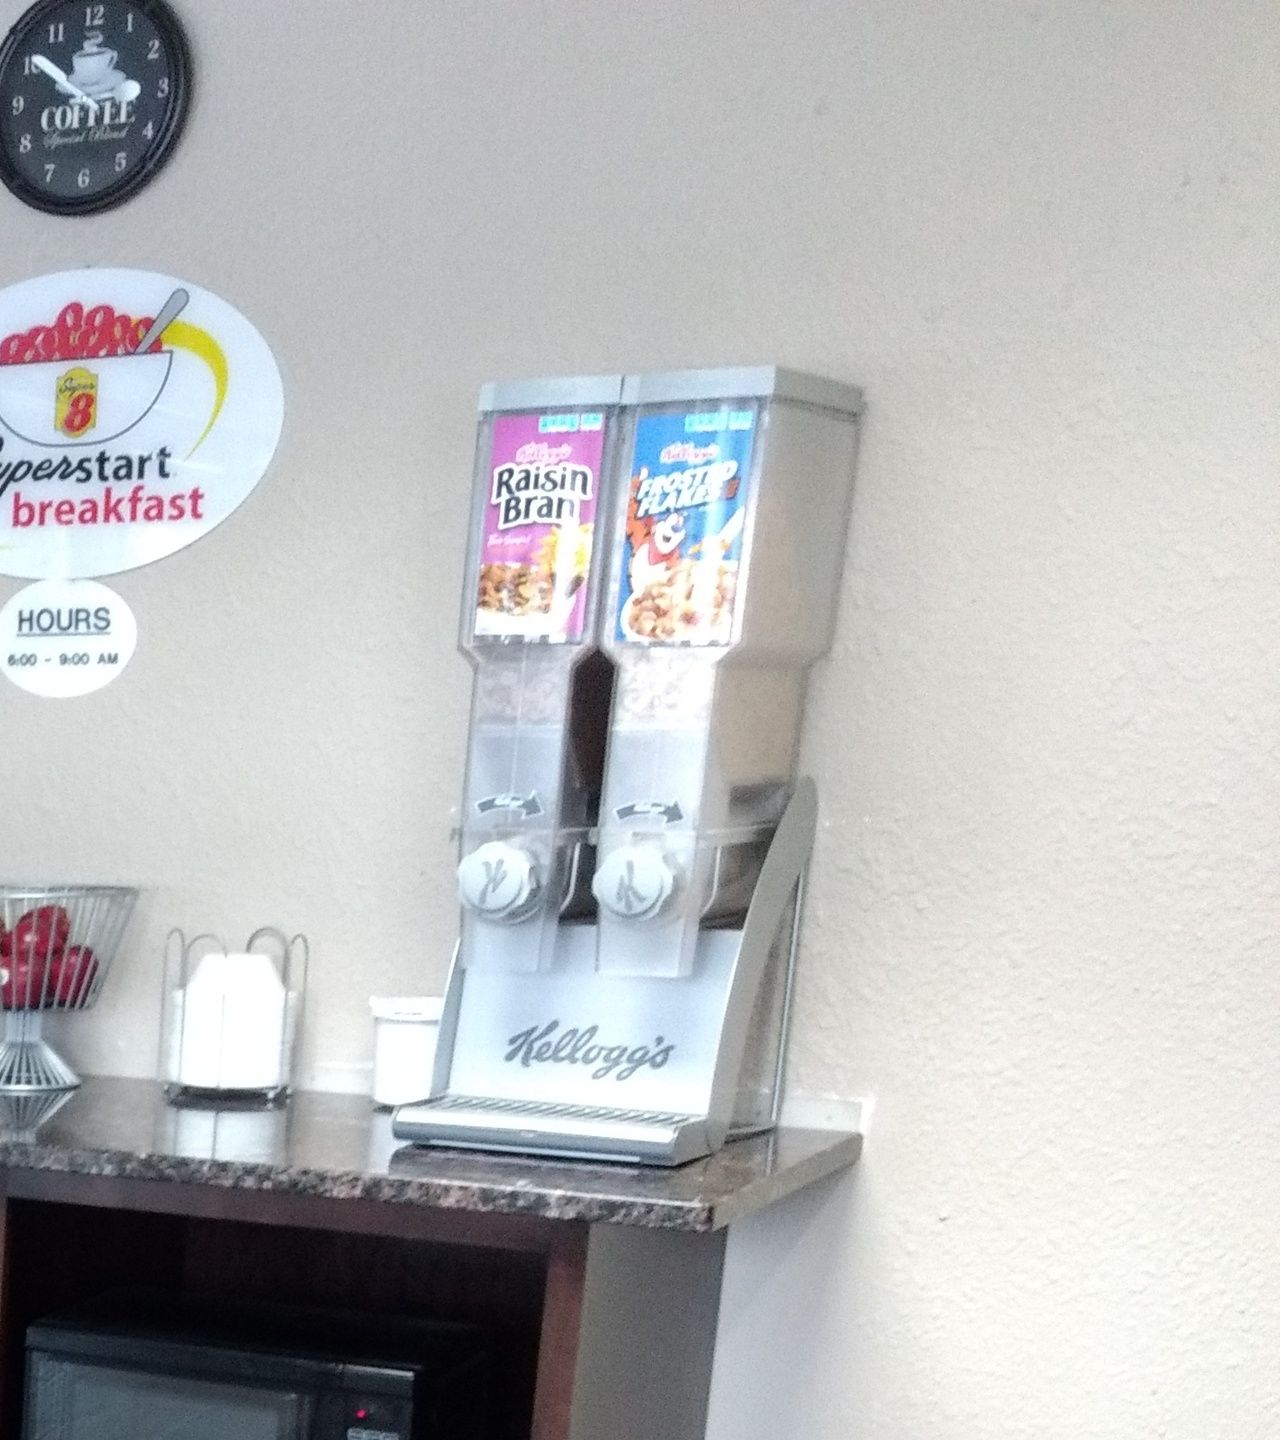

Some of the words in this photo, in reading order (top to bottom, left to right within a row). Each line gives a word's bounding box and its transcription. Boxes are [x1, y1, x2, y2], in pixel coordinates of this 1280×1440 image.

[85, 5, 104, 26] 12
[125, 13, 134, 33] 1
[48, 23, 65, 43] 11
[147, 39, 160, 60] 2
[157, 77, 170, 98] 3
[12, 96, 25, 116] 9
[142, 120, 154, 140] 4
[19, 133, 32, 153] 8
[114, 152, 128, 172] 5
[44, 164, 56, 183] 7
[77, 168, 90, 188] 6
[63, 392, 95, 433] 8
[495, 465, 589, 500] Raisin
[11, 485, 205, 528] breakfast
[502, 496, 575, 524] Bran
[17, 606, 111, 633] HOURS
[97, 653, 119, 665] AM
[504, 1019, 676, 1082] Kellogg's
